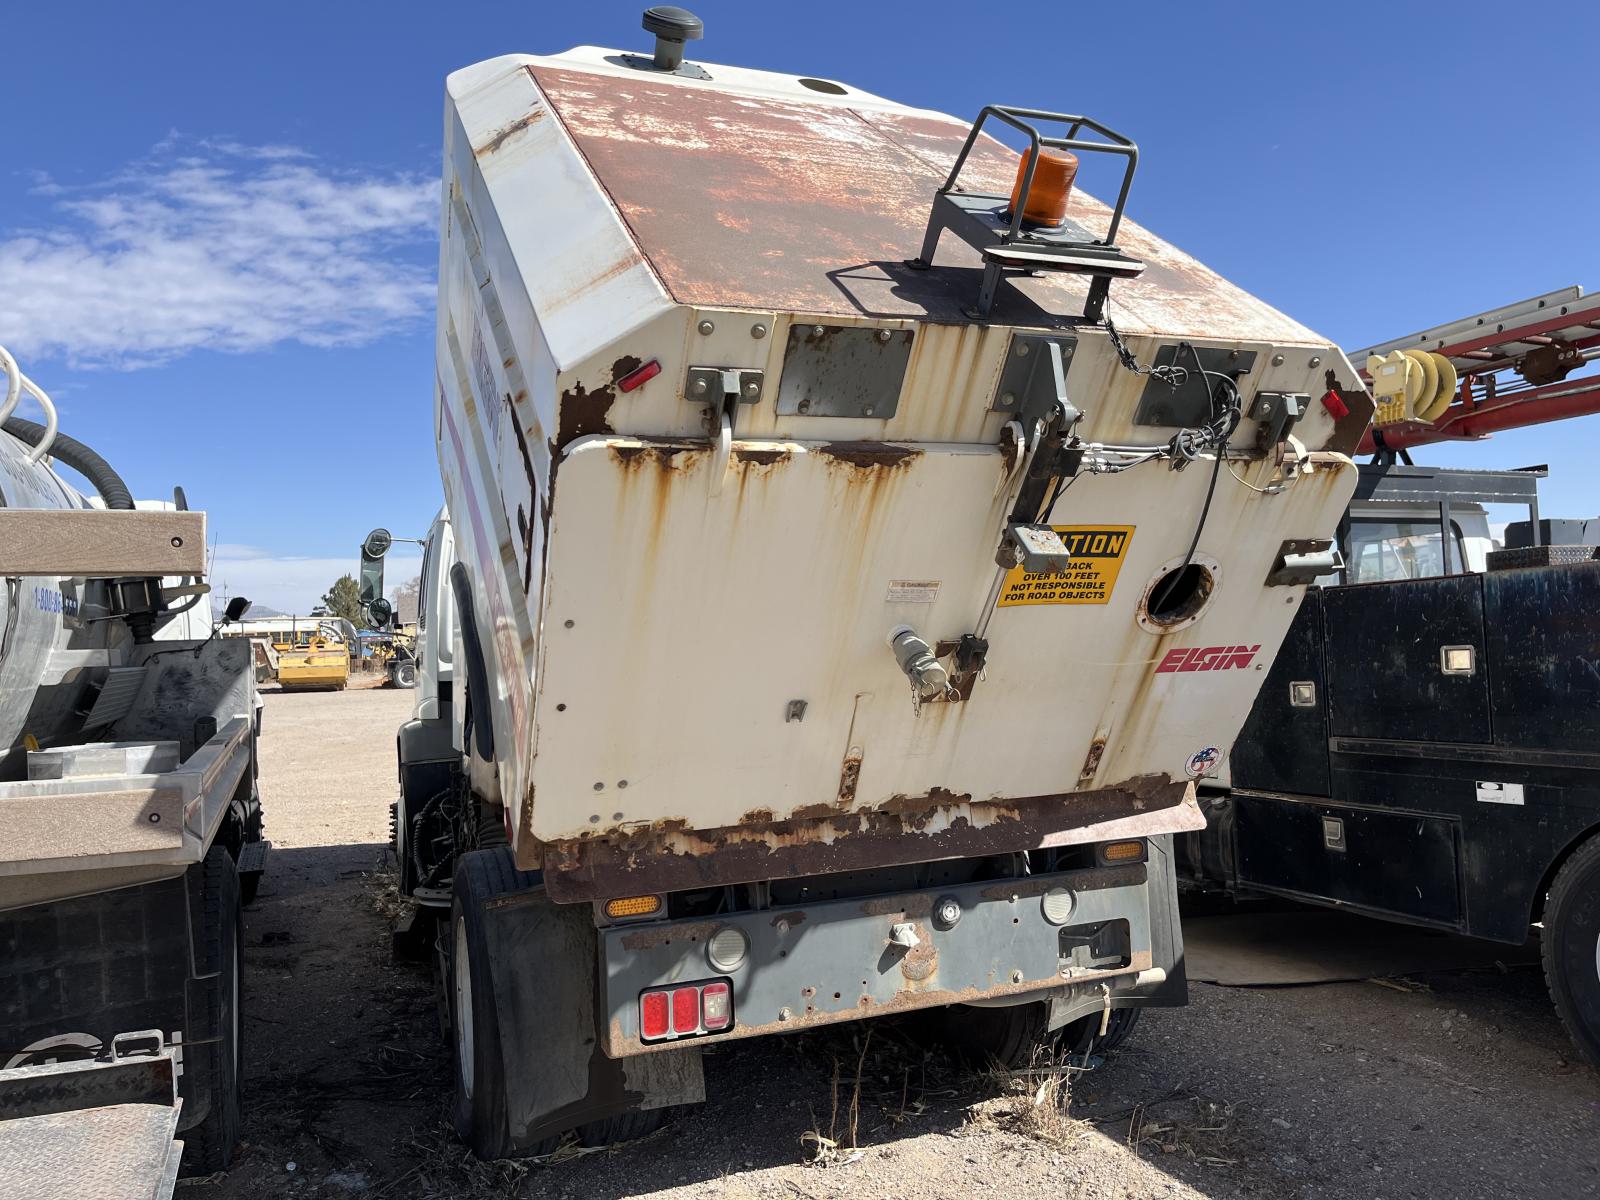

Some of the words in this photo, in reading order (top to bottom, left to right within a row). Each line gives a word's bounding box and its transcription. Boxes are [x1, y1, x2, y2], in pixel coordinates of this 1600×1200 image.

[1023, 572, 1051, 582] OVER
[1054, 572, 1072, 580] 100
[1073, 572, 1100, 580] FEET
[1010, 583, 1032, 592] NOT
[1034, 581, 1106, 590] RESPONSIBLE
[1004, 593, 1025, 601] FOR
[1027, 591, 1055, 600] ROAD
[1058, 591, 1105, 599] OBJECTS
[1154, 645, 1262, 673] ELGIN
